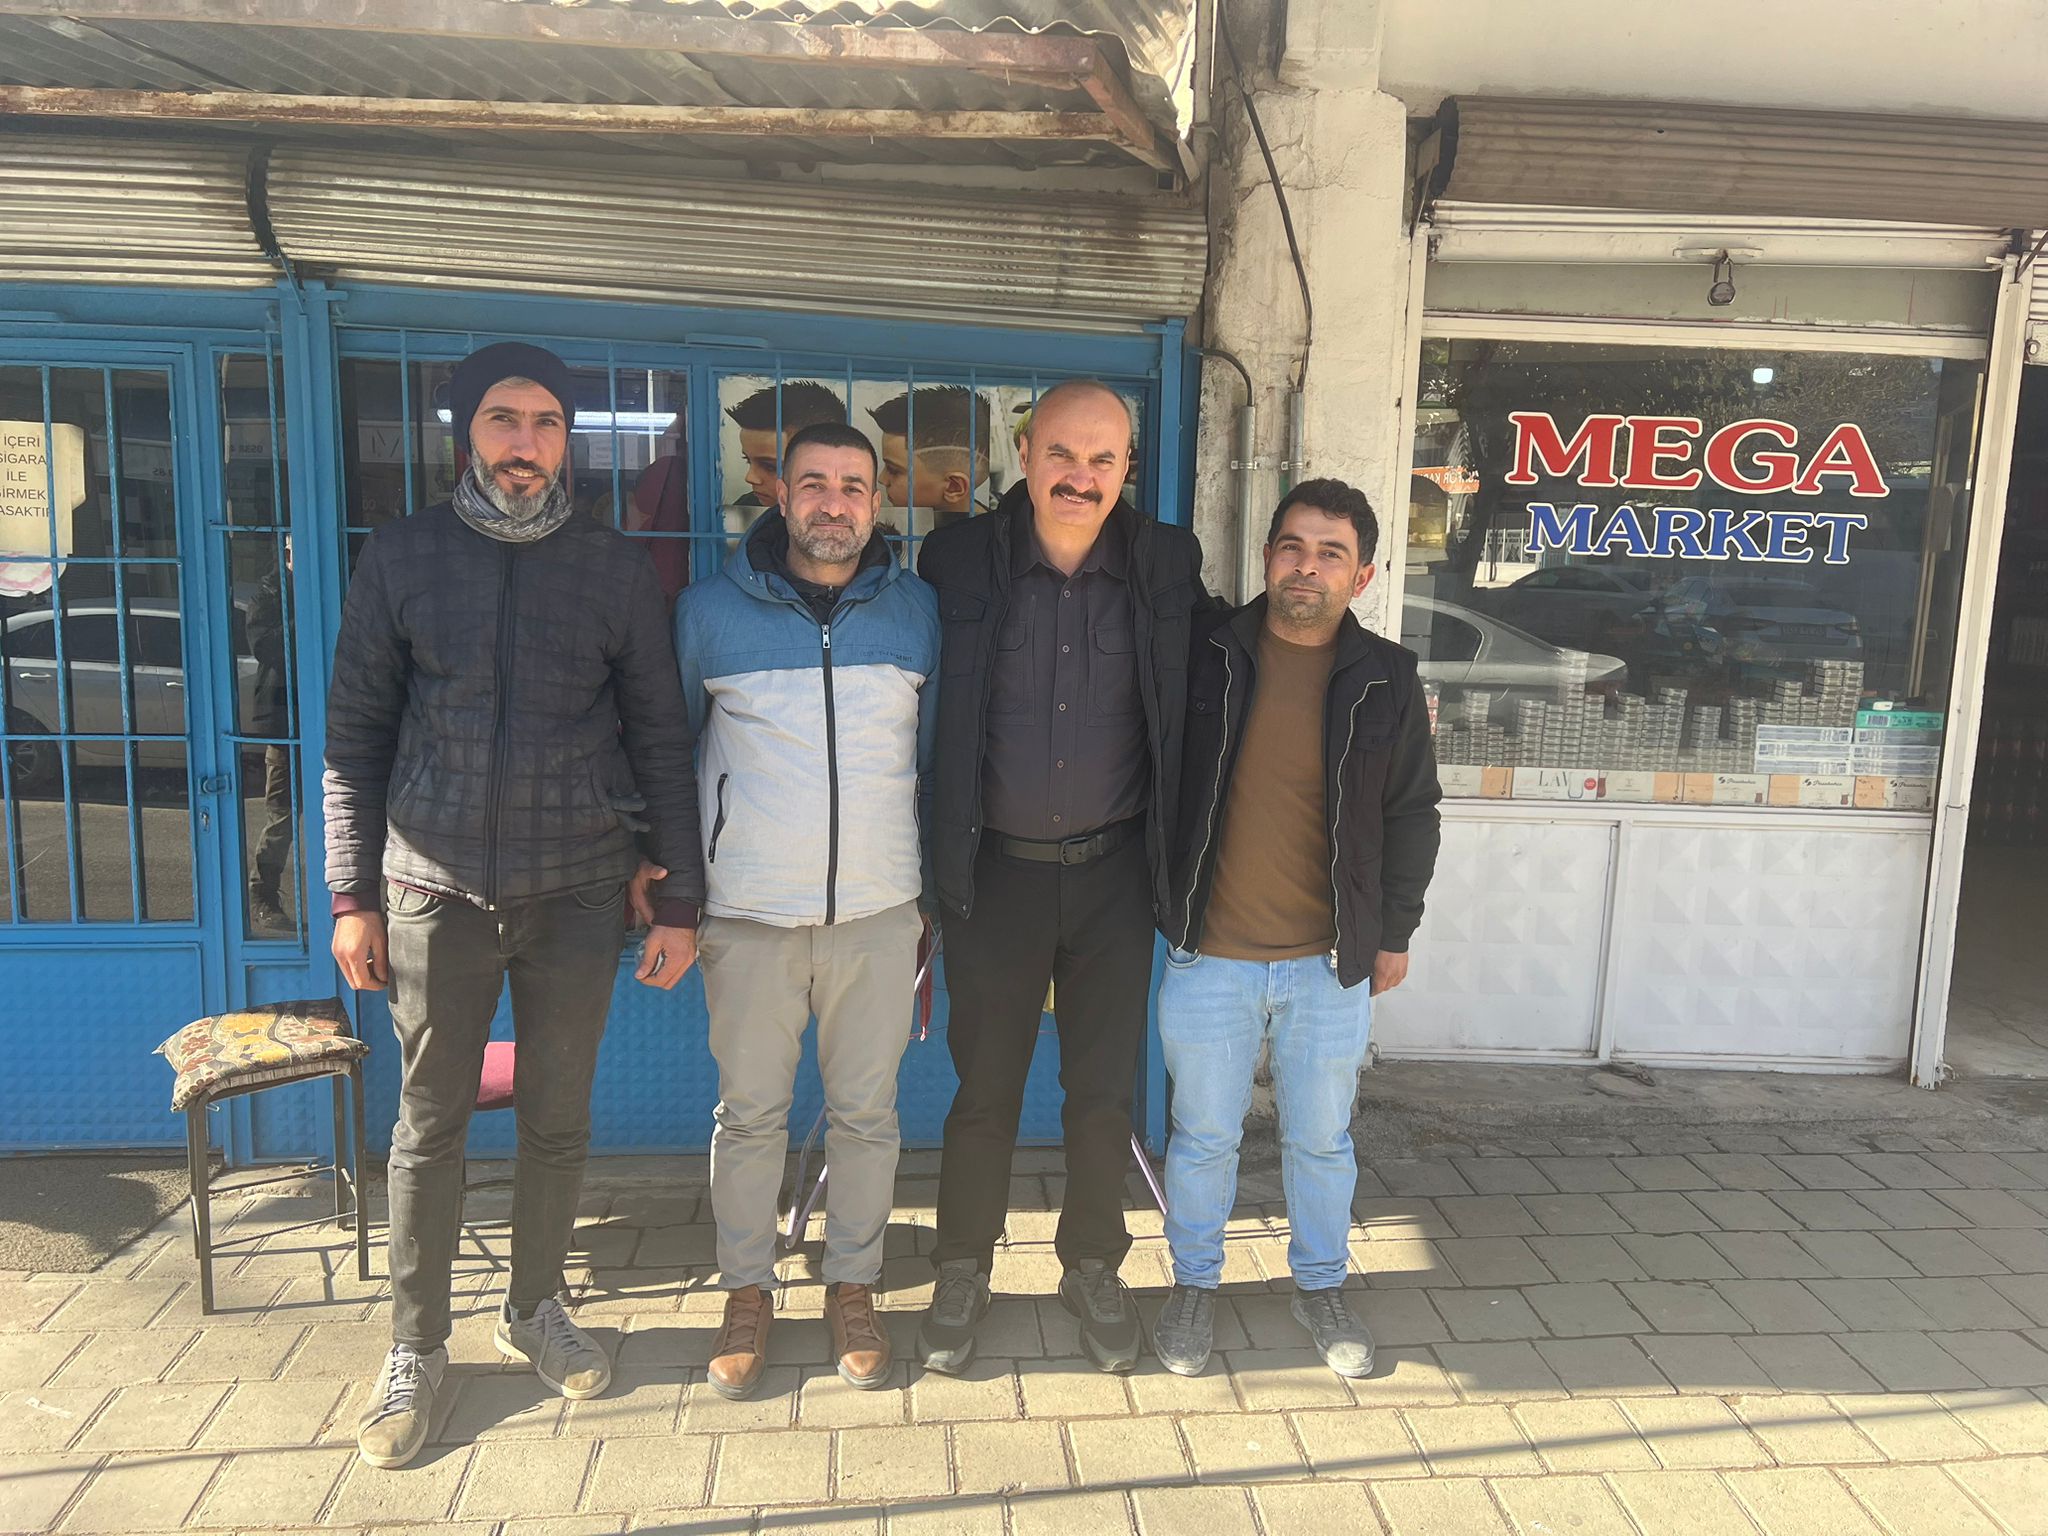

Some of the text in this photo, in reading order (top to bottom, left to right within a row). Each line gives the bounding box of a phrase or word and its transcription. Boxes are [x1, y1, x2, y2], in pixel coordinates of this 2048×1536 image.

[3, 433, 40, 449] İÇERİ
[0, 450, 47, 465] SİGARA
[1504, 411, 1891, 498] MEGA
[7, 468, 27, 482] İLE
[0, 485, 46, 500] İRMEK
[0, 505, 49, 518] ASAKTI
[1524, 502, 1868, 565] MARKET
